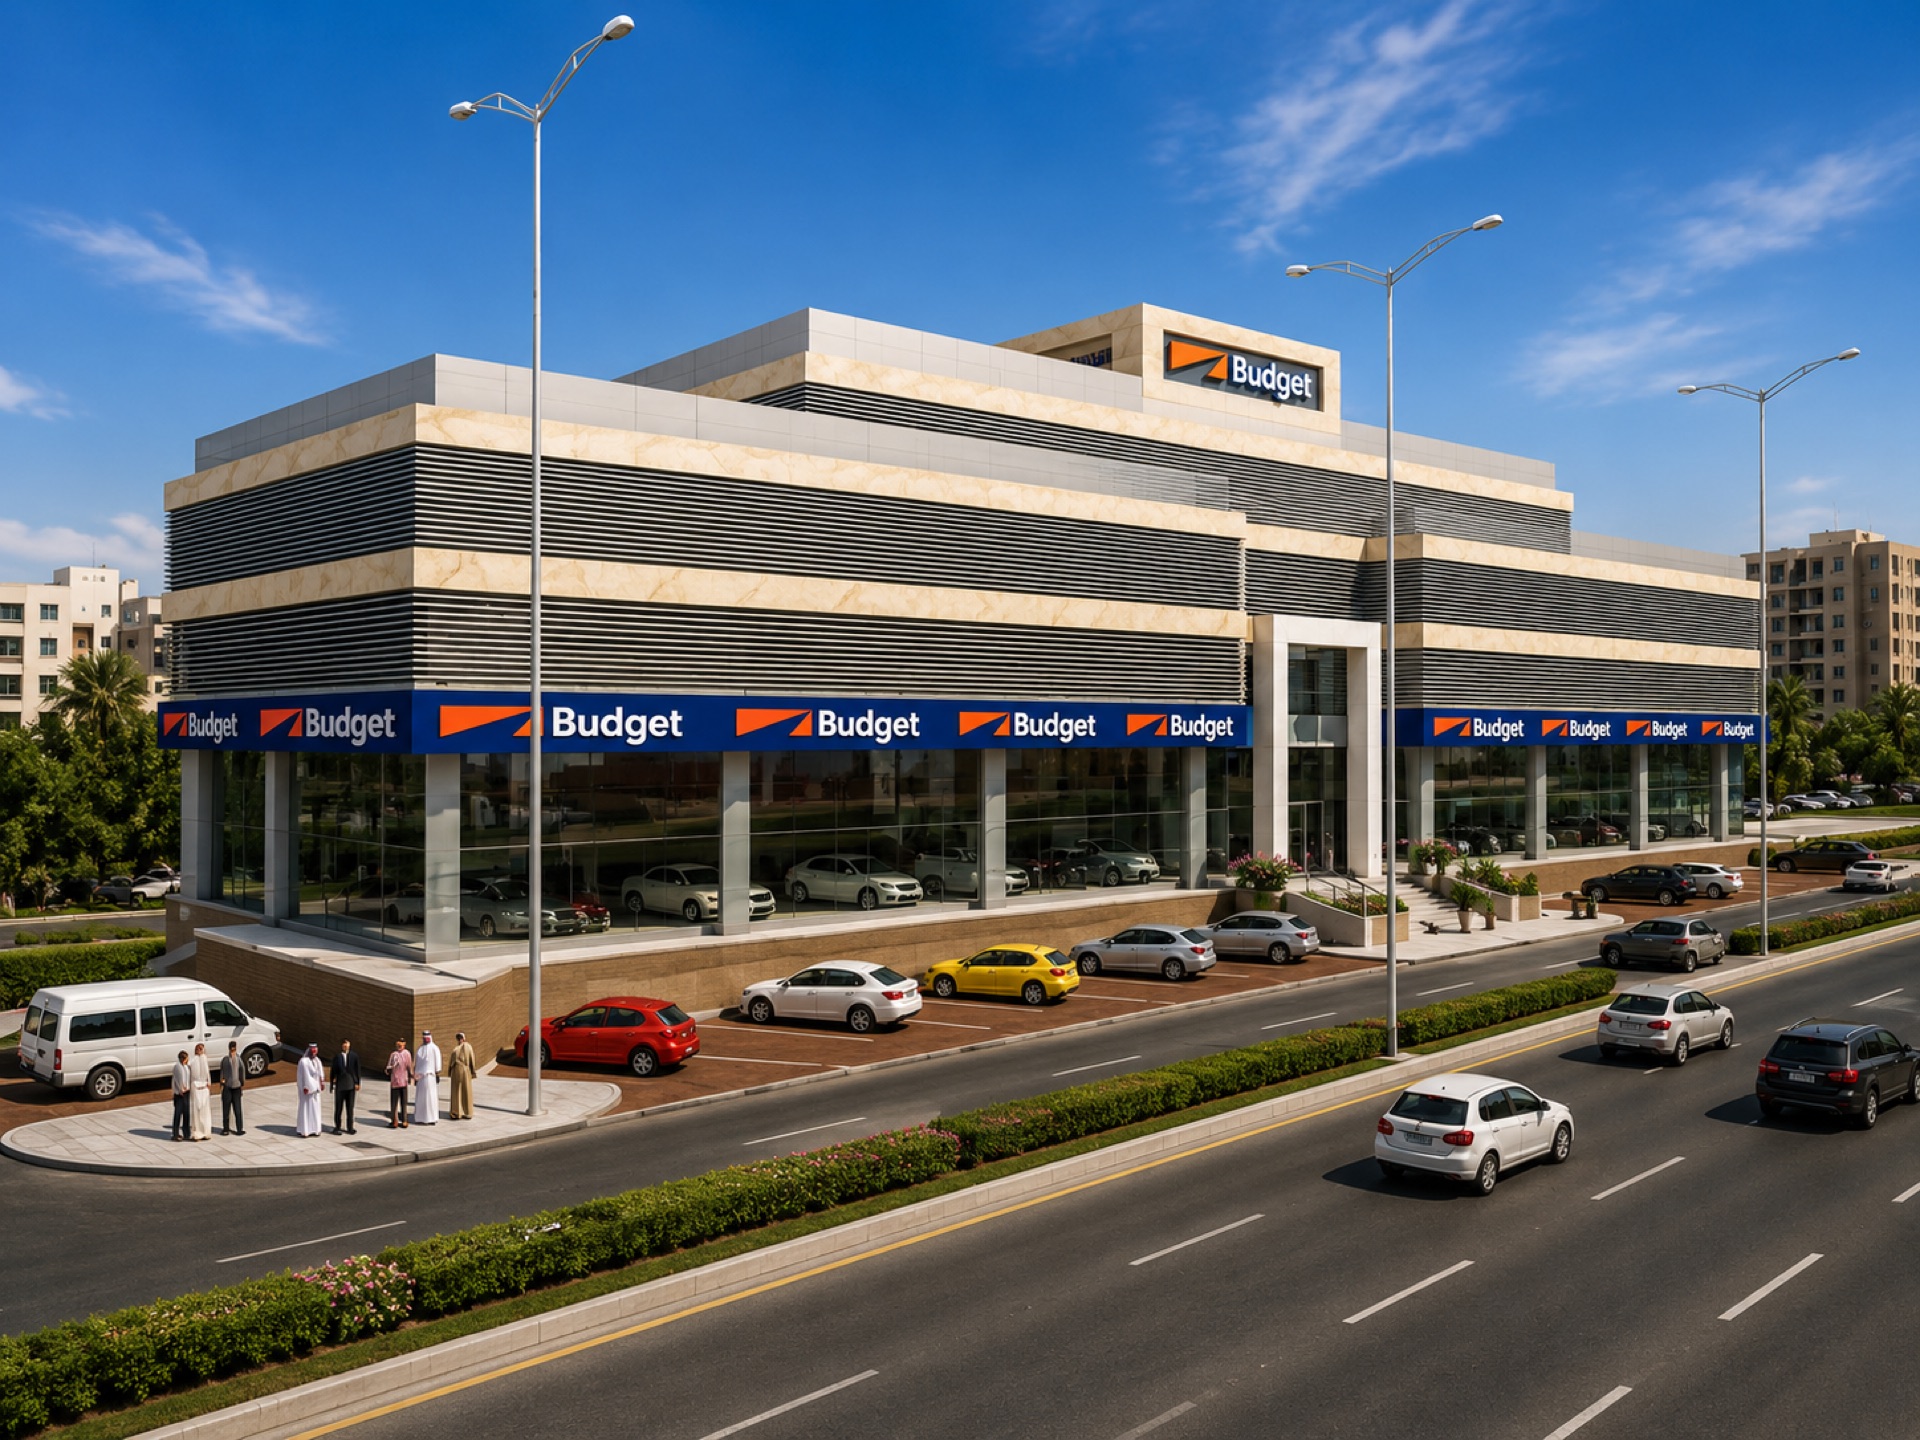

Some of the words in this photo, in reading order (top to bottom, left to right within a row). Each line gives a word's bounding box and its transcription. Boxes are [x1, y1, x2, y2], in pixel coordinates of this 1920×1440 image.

[1232, 354, 1312, 400] Budget
[189, 710, 238, 744] Budget
[305, 706, 395, 746] Budget
[552, 706, 684, 746] Budget
[818, 708, 920, 745] Budget
[1014, 711, 1097, 744] Budget
[1170, 713, 1234, 742] Budget
[1473, 716, 1525, 742] Budget
[1570, 719, 1611, 741] Budget
[1652, 720, 1688, 740] Budget
